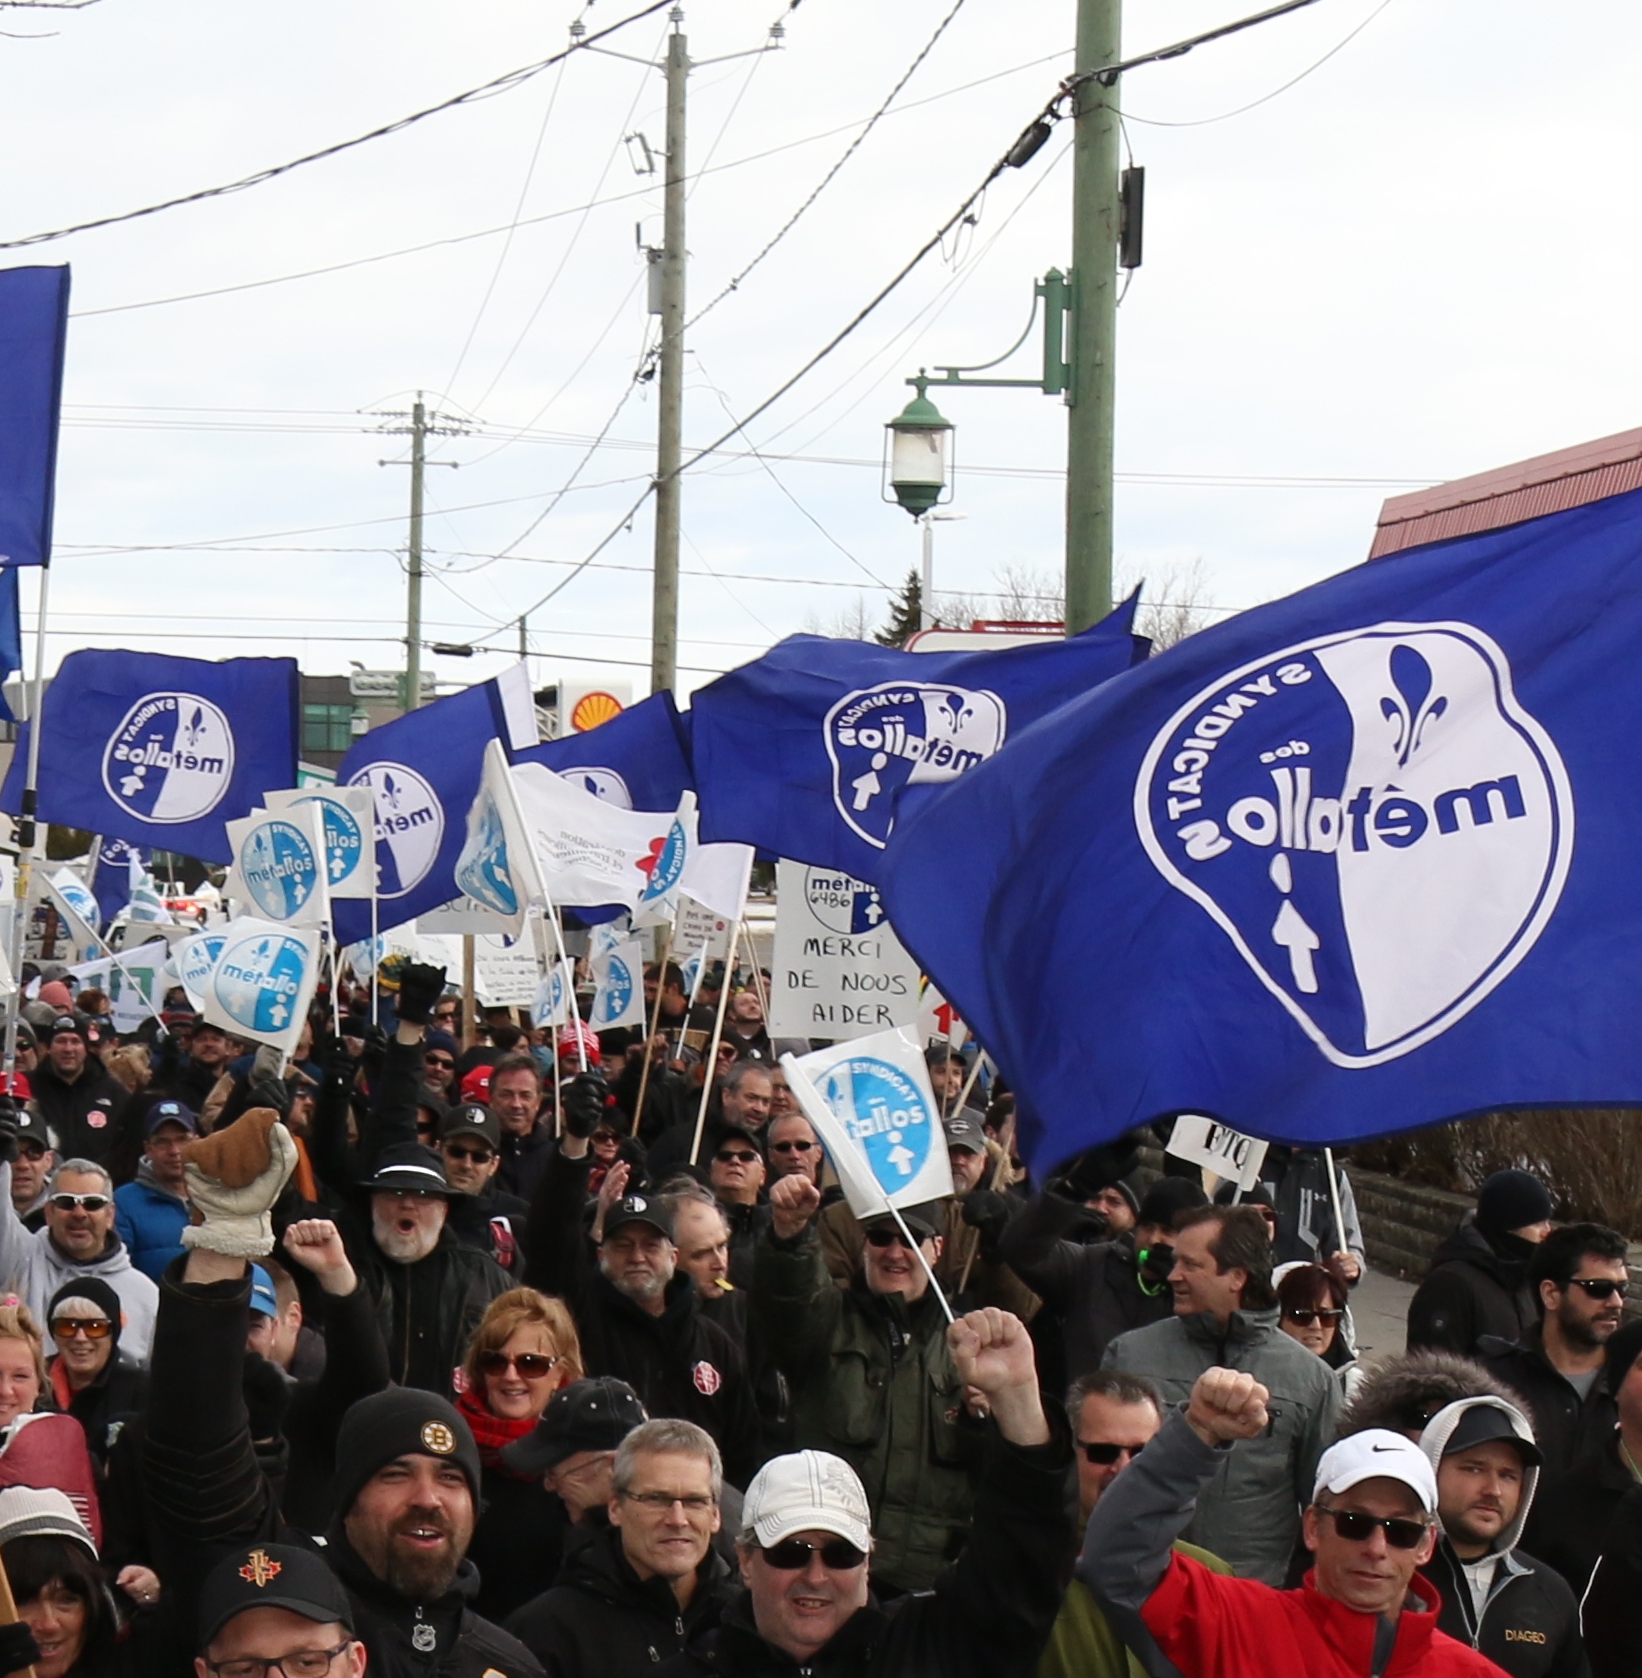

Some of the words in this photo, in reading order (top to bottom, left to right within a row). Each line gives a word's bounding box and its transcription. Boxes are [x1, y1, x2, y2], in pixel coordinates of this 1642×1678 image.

[223, 964, 298, 994] métallo
[788, 971, 820, 989] DE
[842, 972, 908, 995] NOUS
[812, 1004, 895, 1028] AIDER
[852, 1062, 919, 1102] SYNDICAT
[846, 1104, 925, 1140] tallos
[1203, 1123, 1252, 1170] FTQ
[1504, 1629, 1546, 1645] DIAGEO
